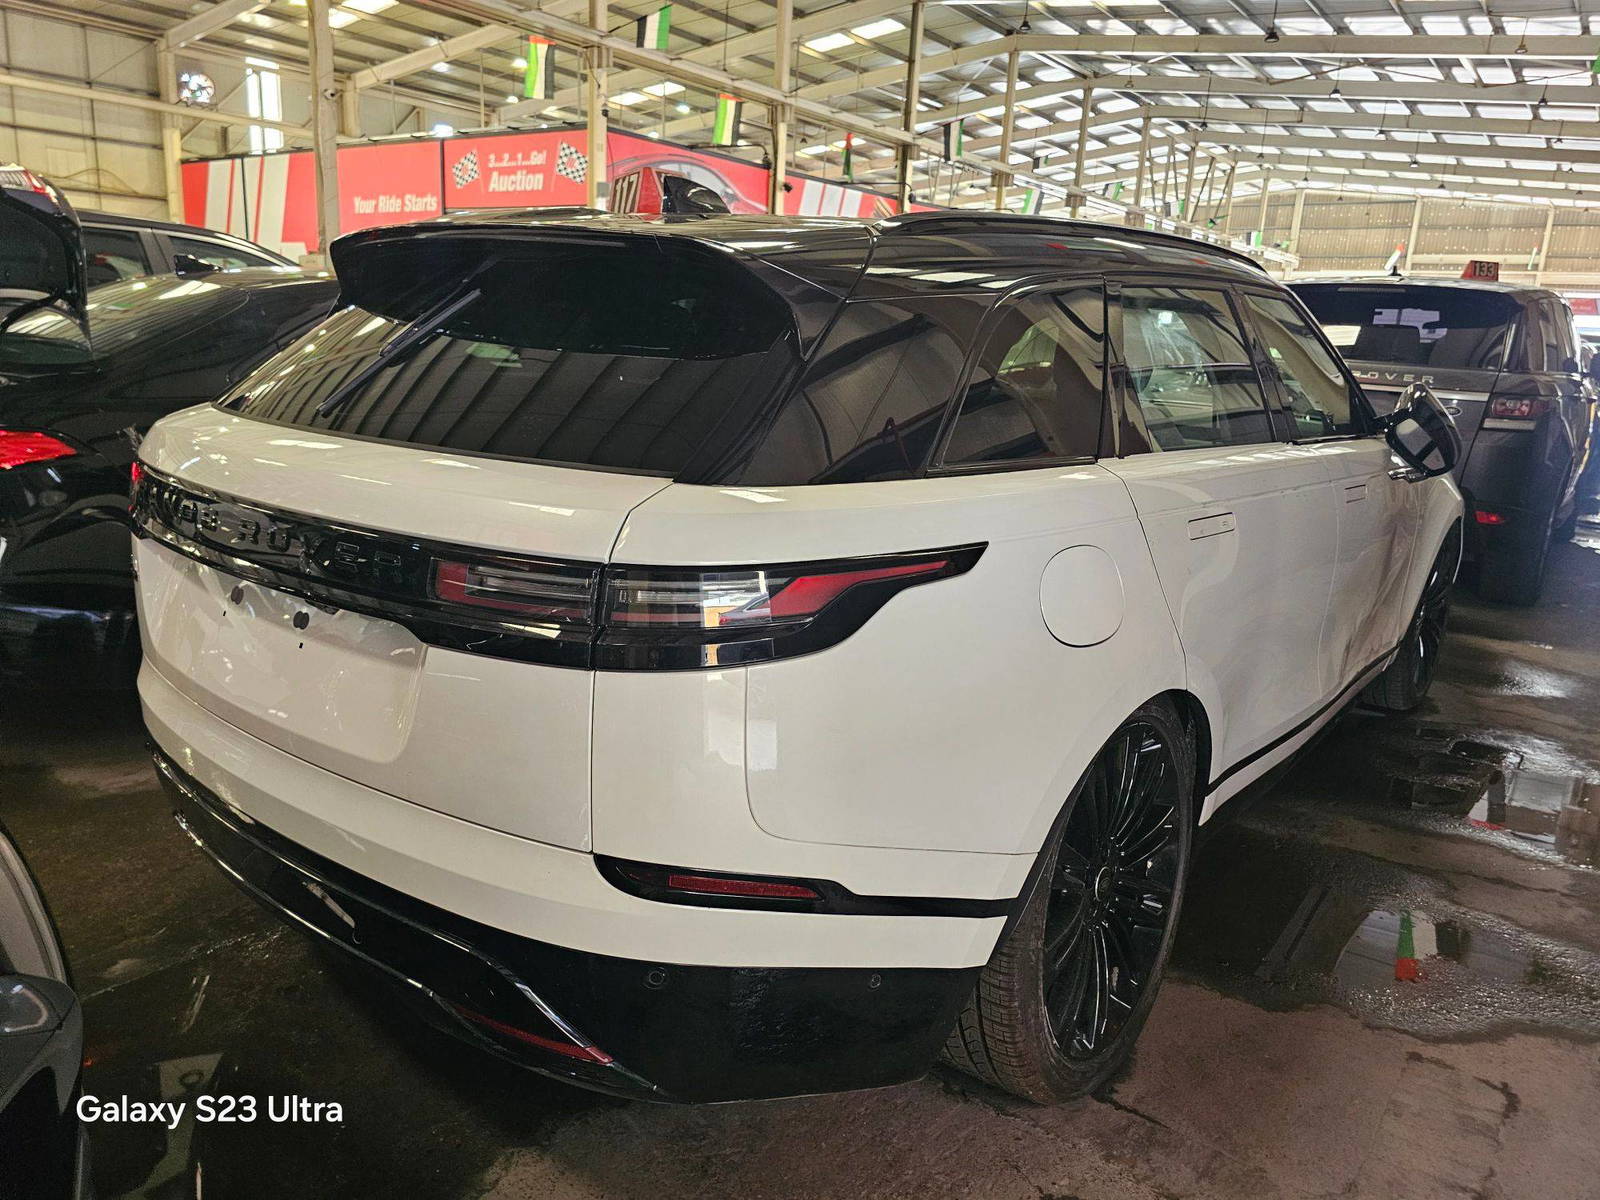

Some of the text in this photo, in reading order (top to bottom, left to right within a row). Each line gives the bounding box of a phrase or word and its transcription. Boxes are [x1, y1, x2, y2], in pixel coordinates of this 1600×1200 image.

[488, 170, 544, 192] Auction
[353, 193, 438, 214] Your Ride Starts
[613, 173, 639, 215] 117
[1475, 261, 1495, 277] 133
